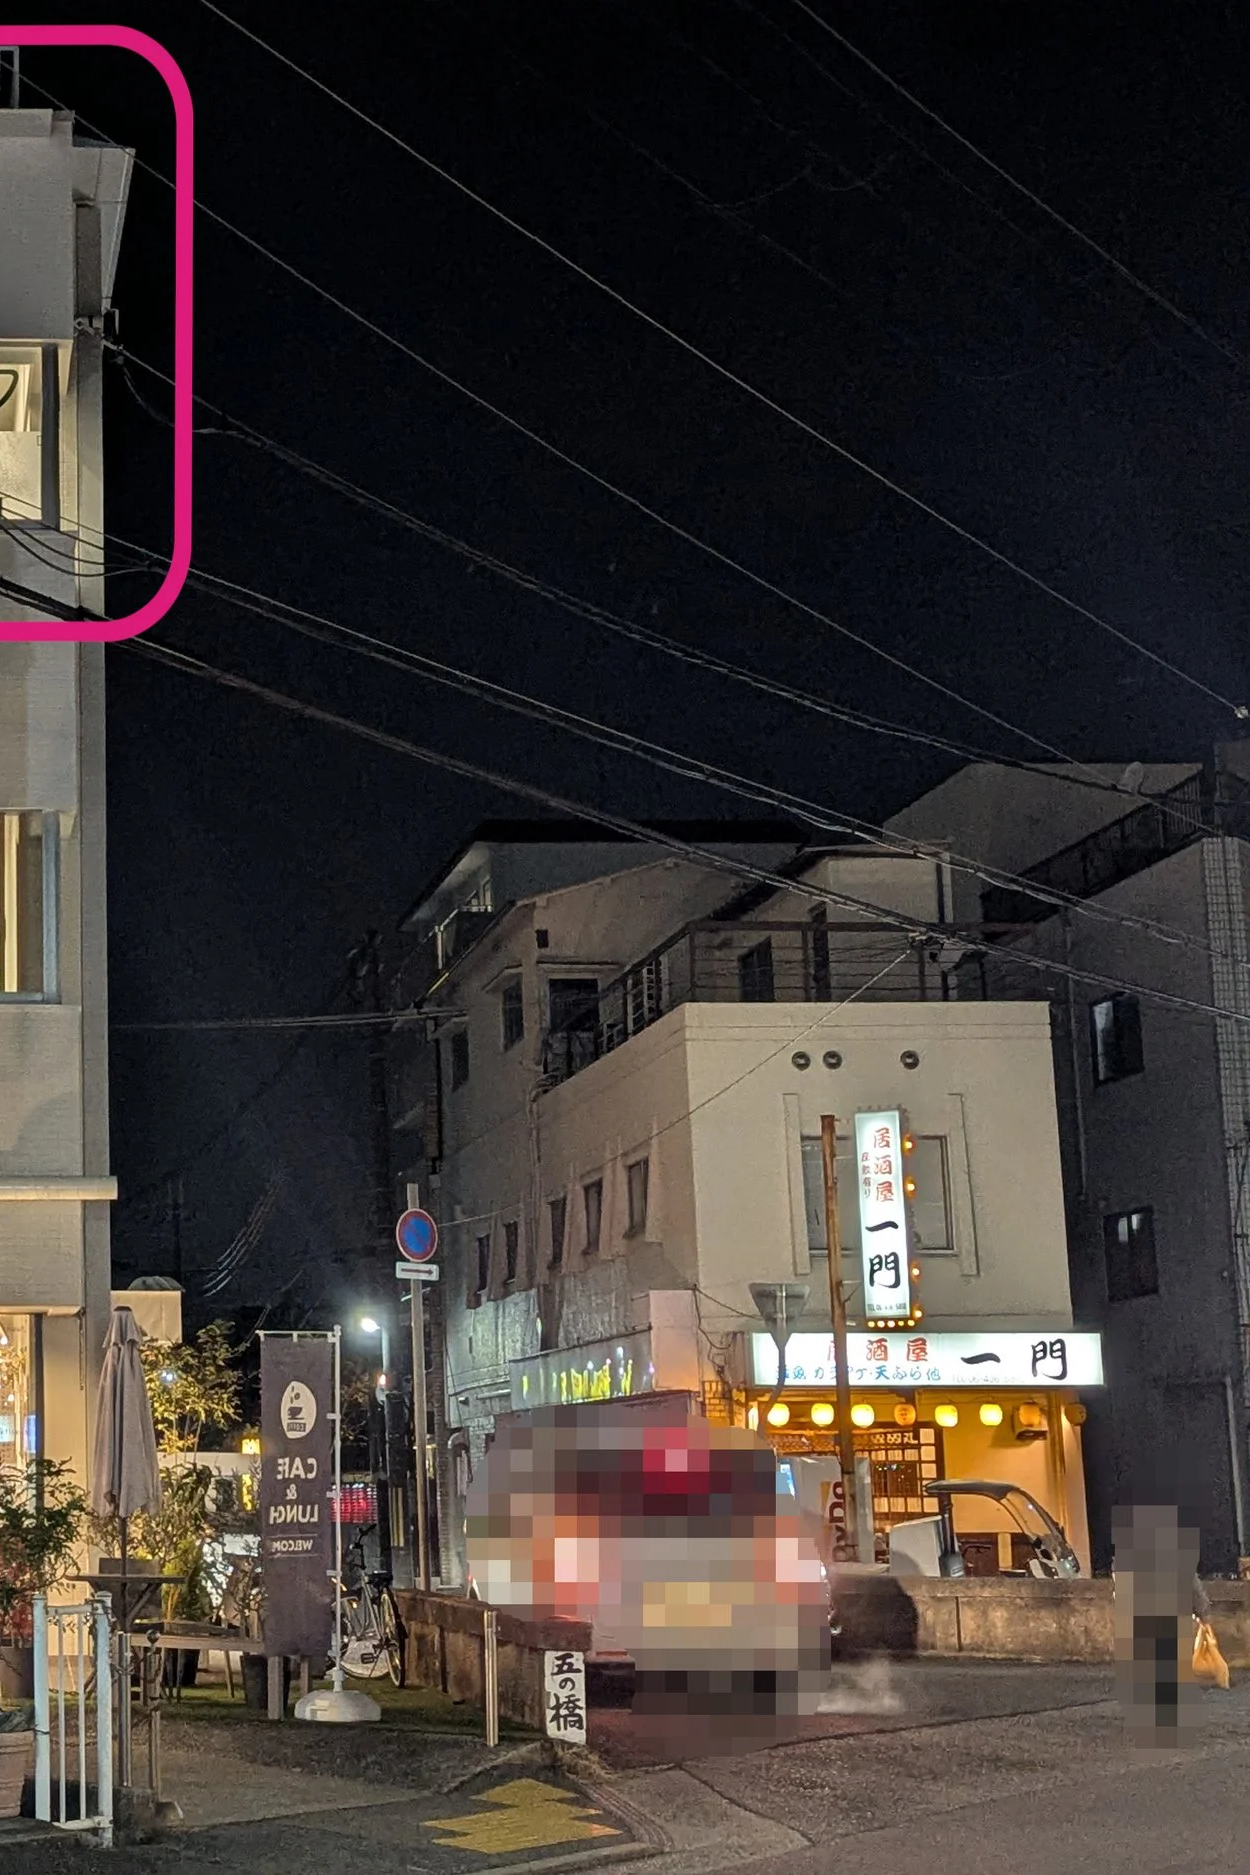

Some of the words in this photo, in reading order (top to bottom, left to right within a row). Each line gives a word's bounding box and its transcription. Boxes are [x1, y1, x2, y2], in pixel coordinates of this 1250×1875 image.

[873, 1127, 895, 1202] 居酒屋
[865, 1220, 901, 1288] 一門
[960, 1338, 1068, 1380] 一門
[550, 1653, 583, 1732] 五の橋
